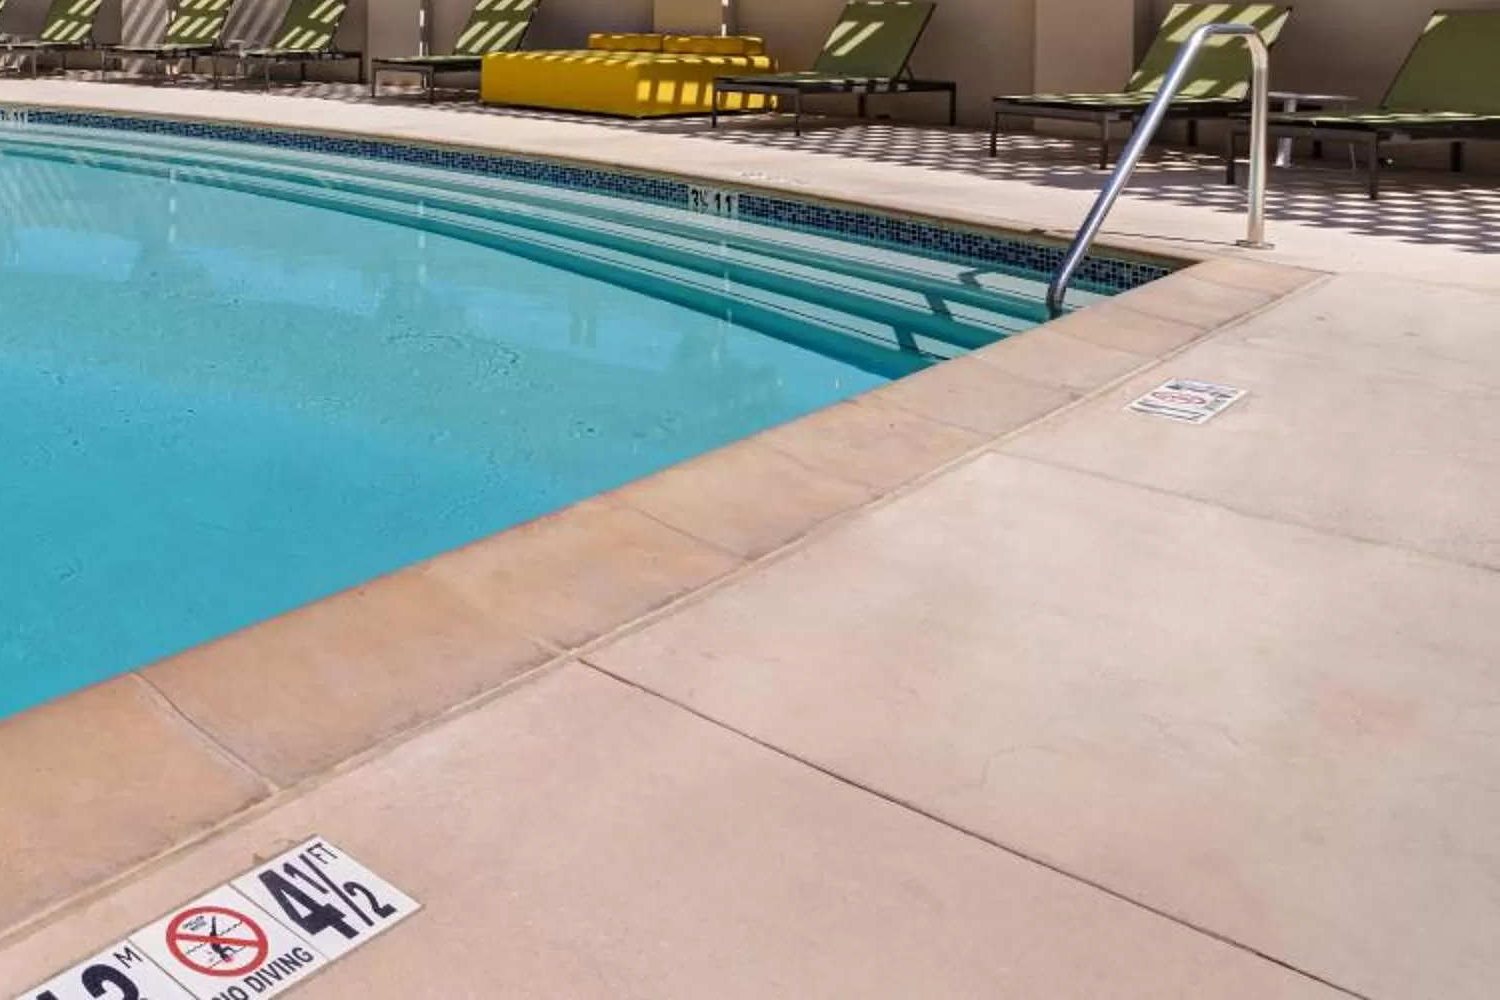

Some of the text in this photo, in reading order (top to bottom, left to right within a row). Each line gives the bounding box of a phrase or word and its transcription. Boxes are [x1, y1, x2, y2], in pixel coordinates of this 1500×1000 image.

[306, 842, 338, 865] FT
[112, 947, 143, 968] M
[243, 947, 314, 993] DIVING
